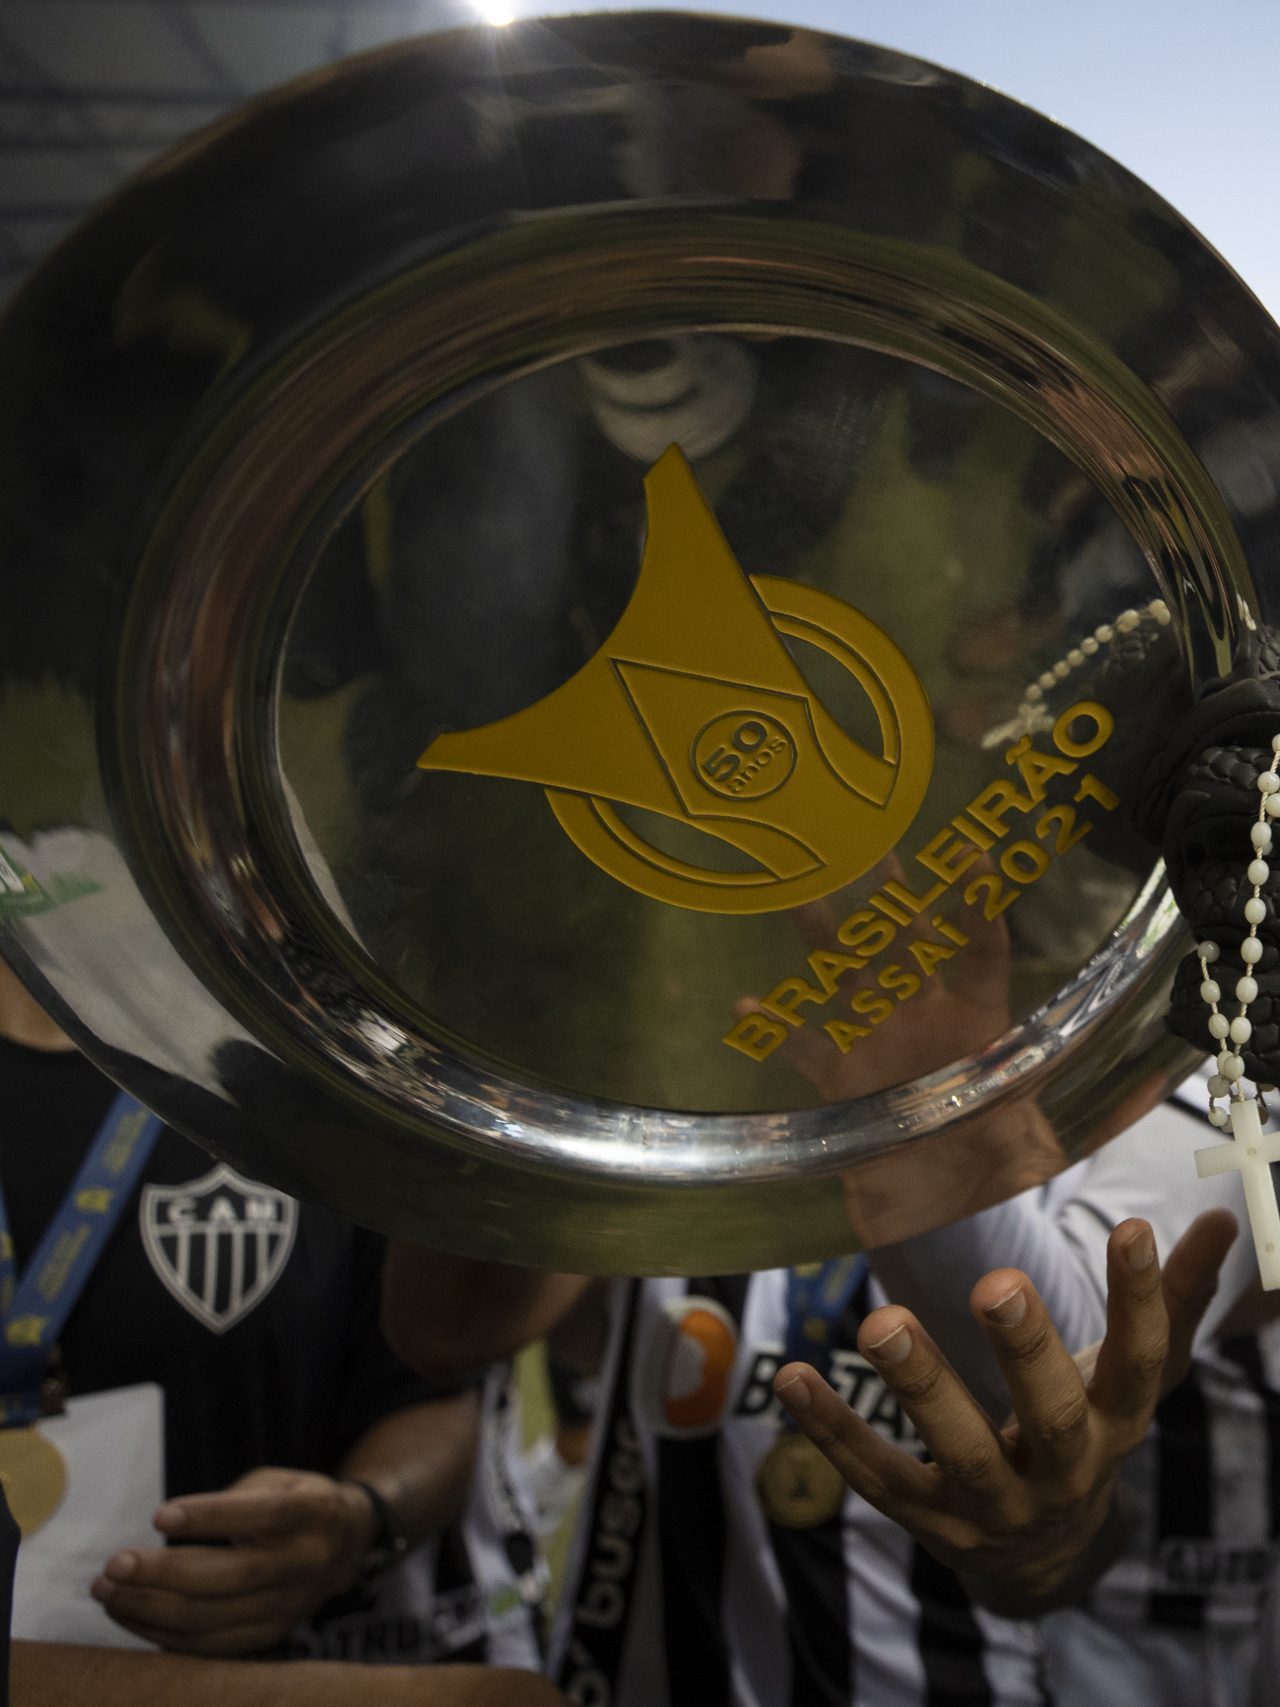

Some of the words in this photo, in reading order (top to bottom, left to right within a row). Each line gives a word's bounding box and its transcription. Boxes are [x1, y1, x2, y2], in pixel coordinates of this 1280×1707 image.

[702, 719, 768, 783] 50
[729, 735, 787, 794] anos
[964, 774, 1121, 922] 2021
[722, 701, 1114, 1062] BRASILEIRÃO
[165, 1196, 279, 1224] CAM
